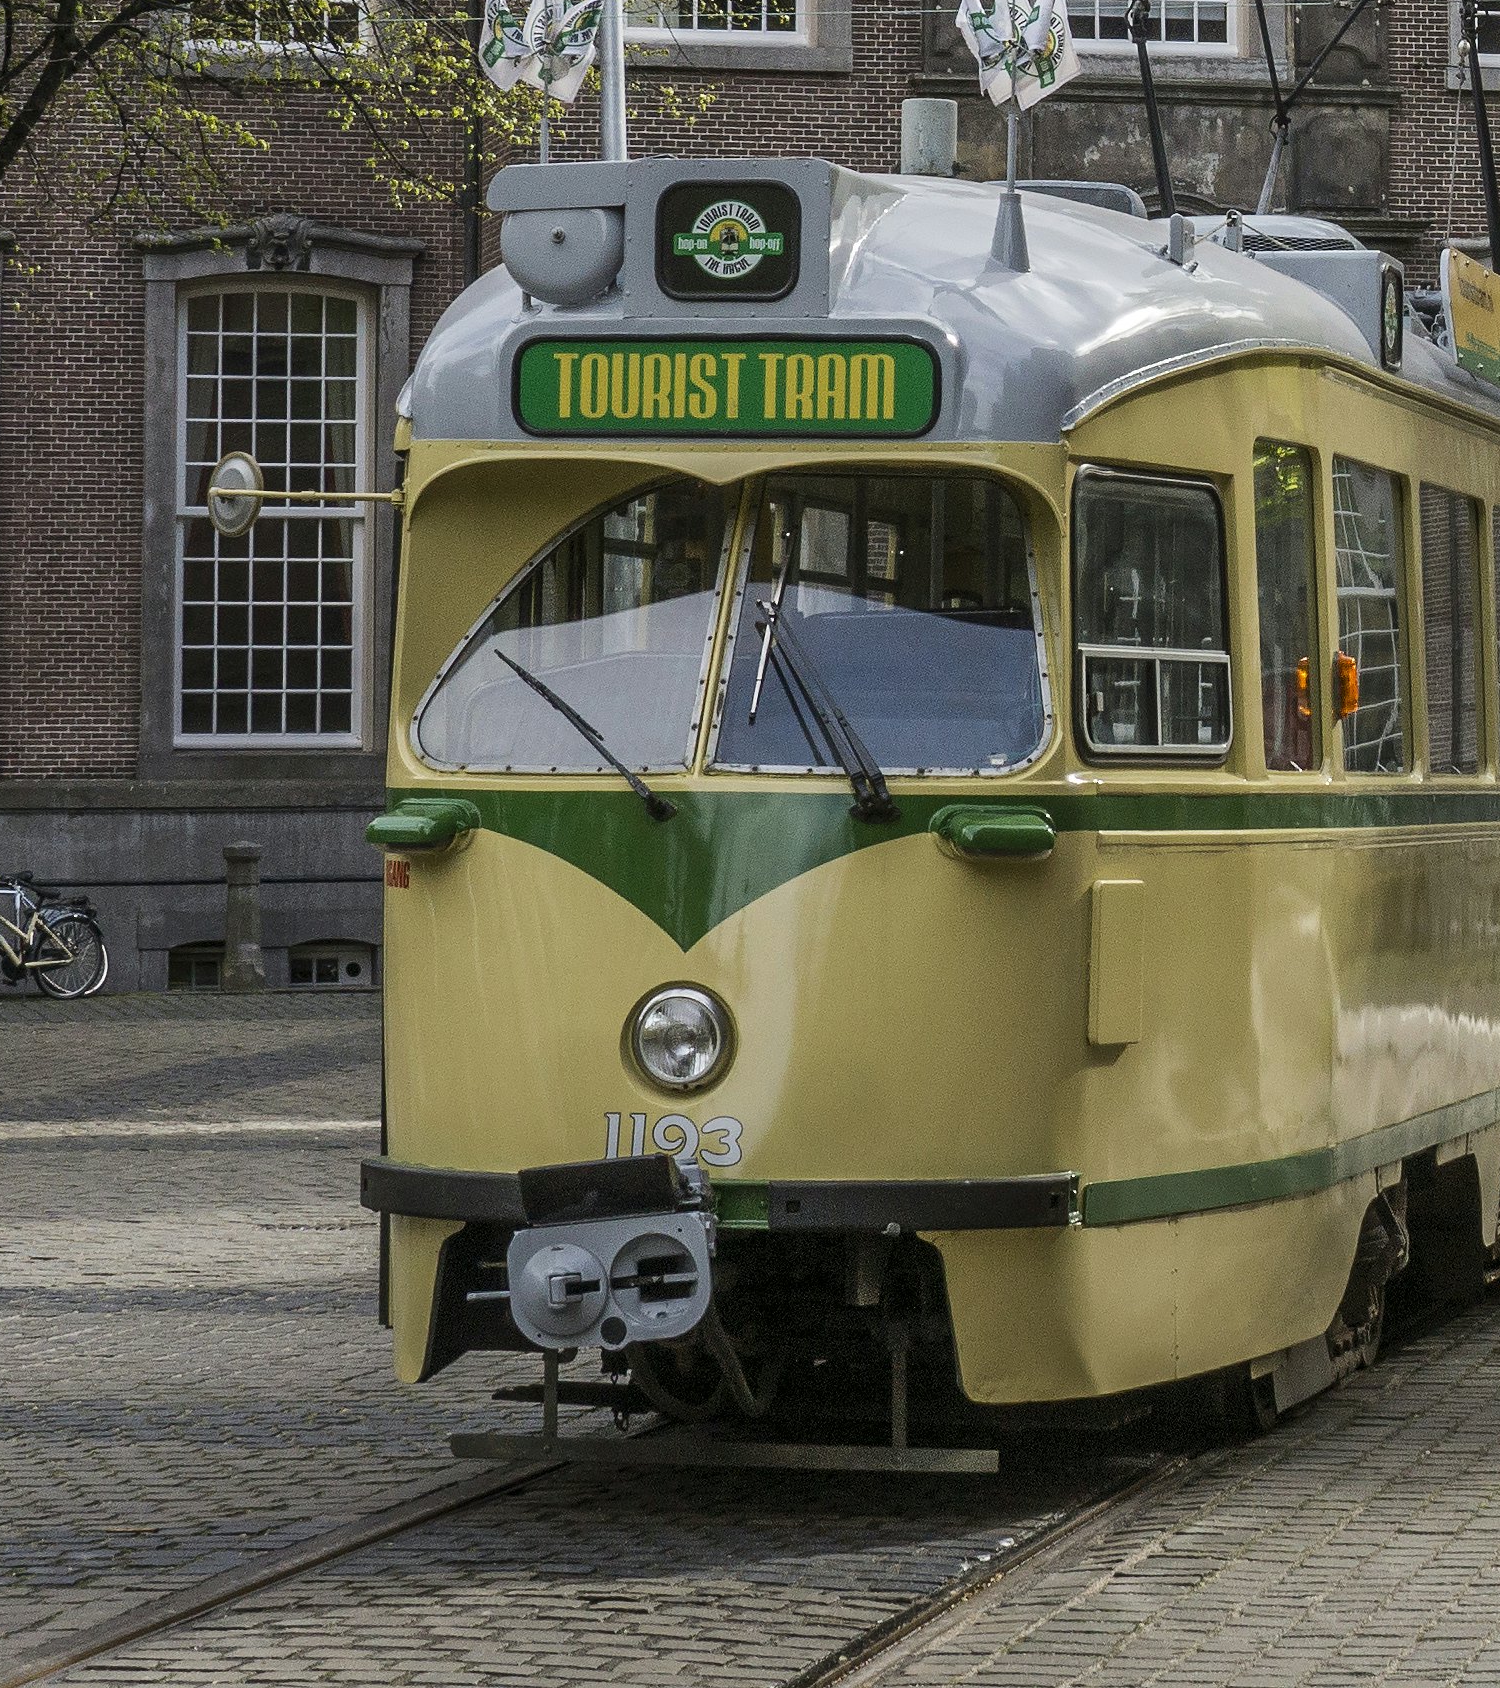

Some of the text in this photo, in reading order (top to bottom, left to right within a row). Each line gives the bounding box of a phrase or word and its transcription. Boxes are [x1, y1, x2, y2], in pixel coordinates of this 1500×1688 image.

[697, 204, 761, 232] TOURIST TRAM
[704, 257, 719, 273] THE
[553, 352, 896, 420] TOURIST TRAM
[604, 1112, 744, 1167] 1193
